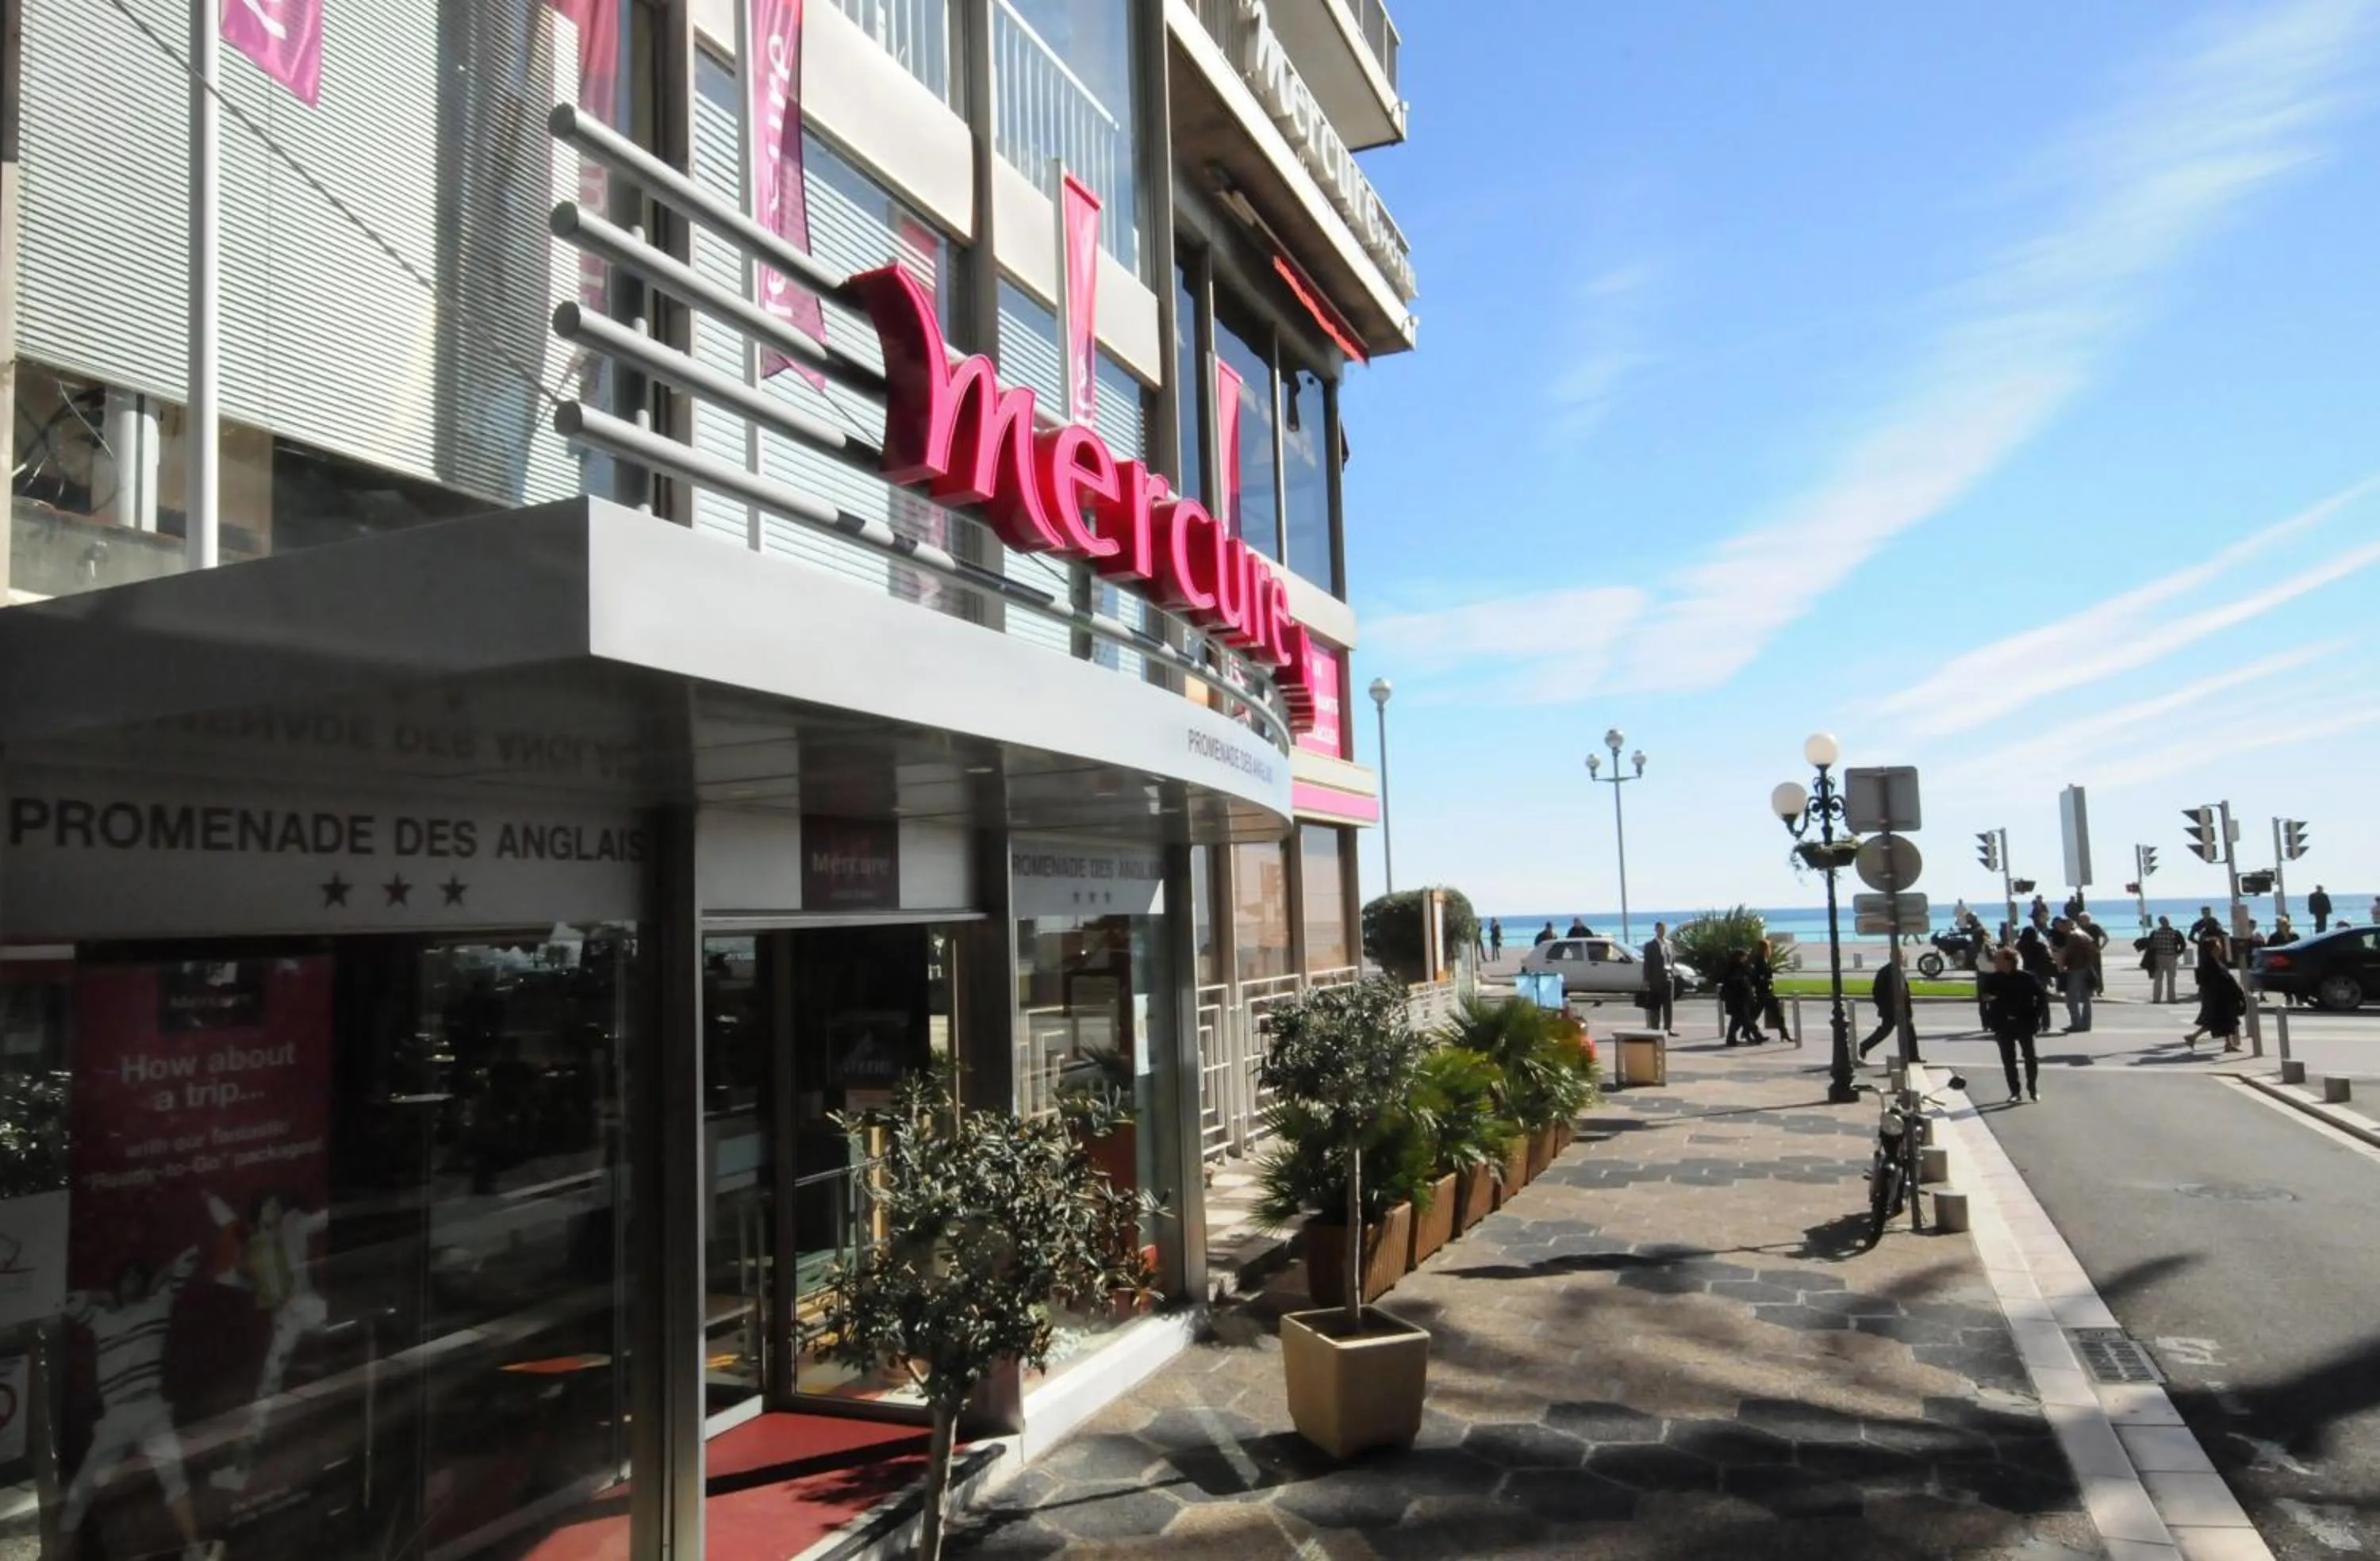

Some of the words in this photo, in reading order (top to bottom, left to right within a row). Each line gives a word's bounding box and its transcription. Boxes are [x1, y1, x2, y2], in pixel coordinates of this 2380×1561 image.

[7, 797, 376, 856] PROMENADE
[394, 817, 478, 859] DES
[496, 823, 646, 861] ANGLAIS
[121, 1053, 198, 1084] How
[207, 1041, 297, 1073] about
[153, 1089, 175, 1112] a
[186, 1076, 266, 1110] trip...
[125, 1138, 168, 1159] with
[174, 1133, 206, 1153] our
[211, 1120, 290, 1145] fantastic
